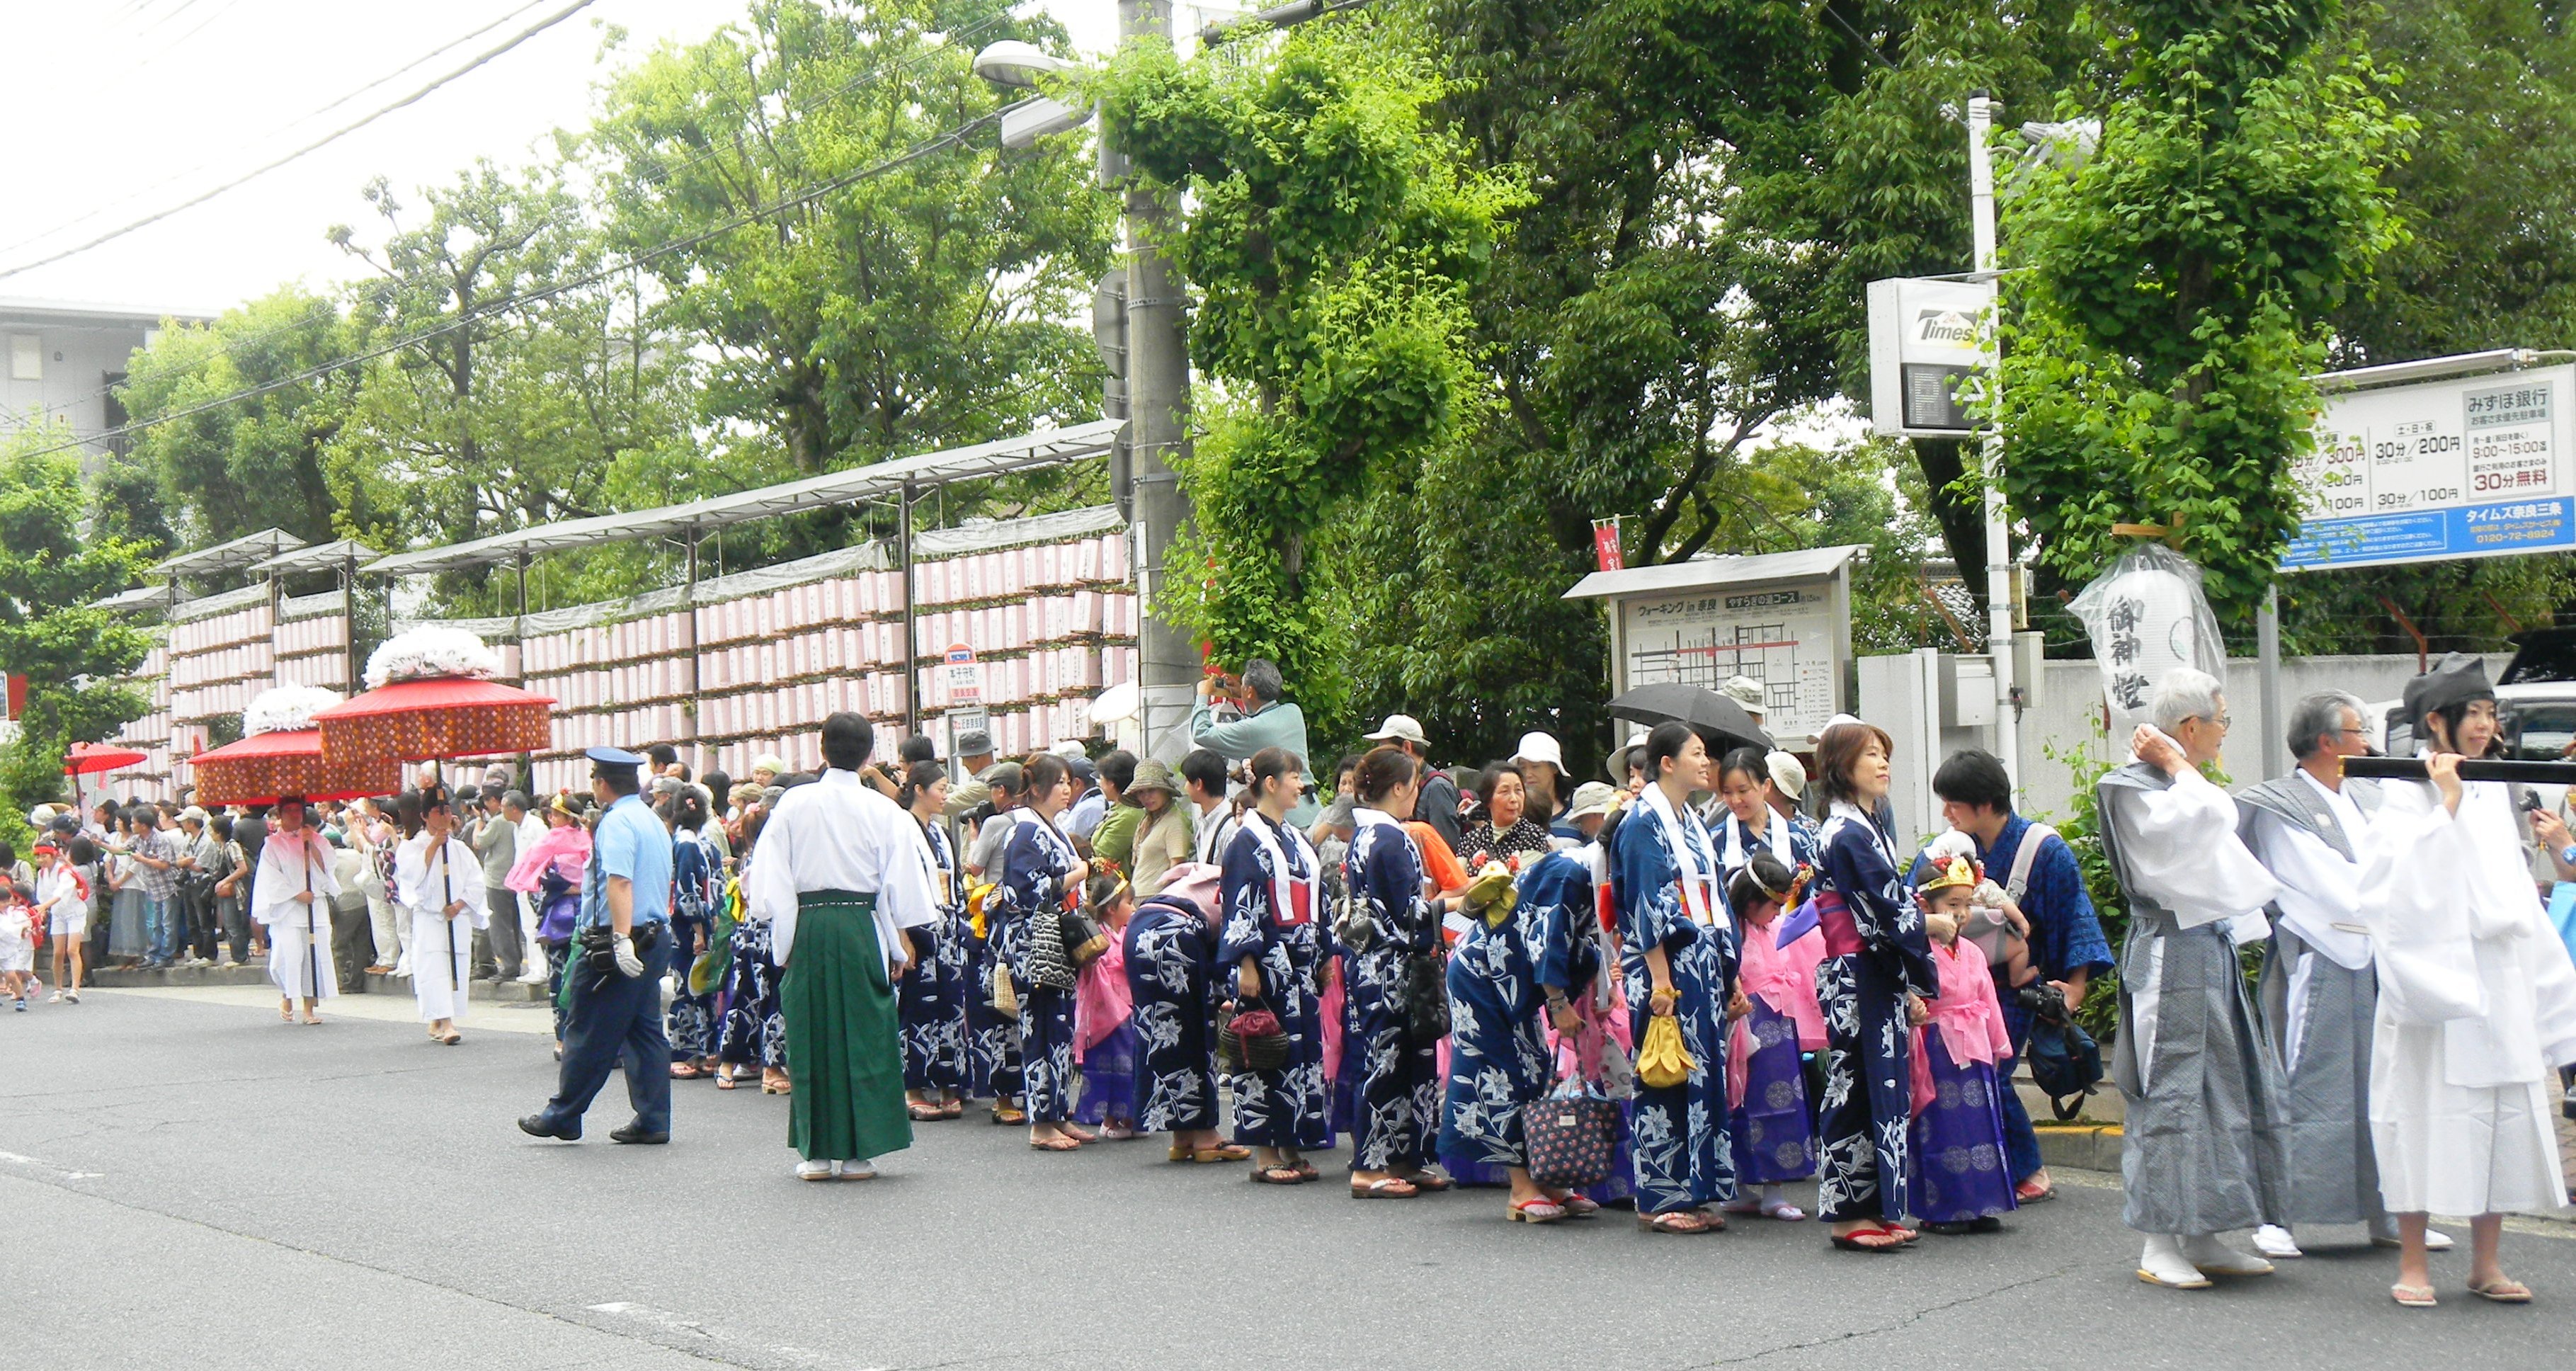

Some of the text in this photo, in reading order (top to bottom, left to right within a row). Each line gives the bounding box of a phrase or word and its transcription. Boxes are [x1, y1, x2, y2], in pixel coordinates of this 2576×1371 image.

[1920, 316, 1973, 341] Times
[2468, 389, 2548, 412] みずほ銀行
[2475, 468, 2548, 491] 30分無料
[2466, 501, 2563, 523] タイムズ奈良三条
[1698, 598, 1716, 611] 奈良
